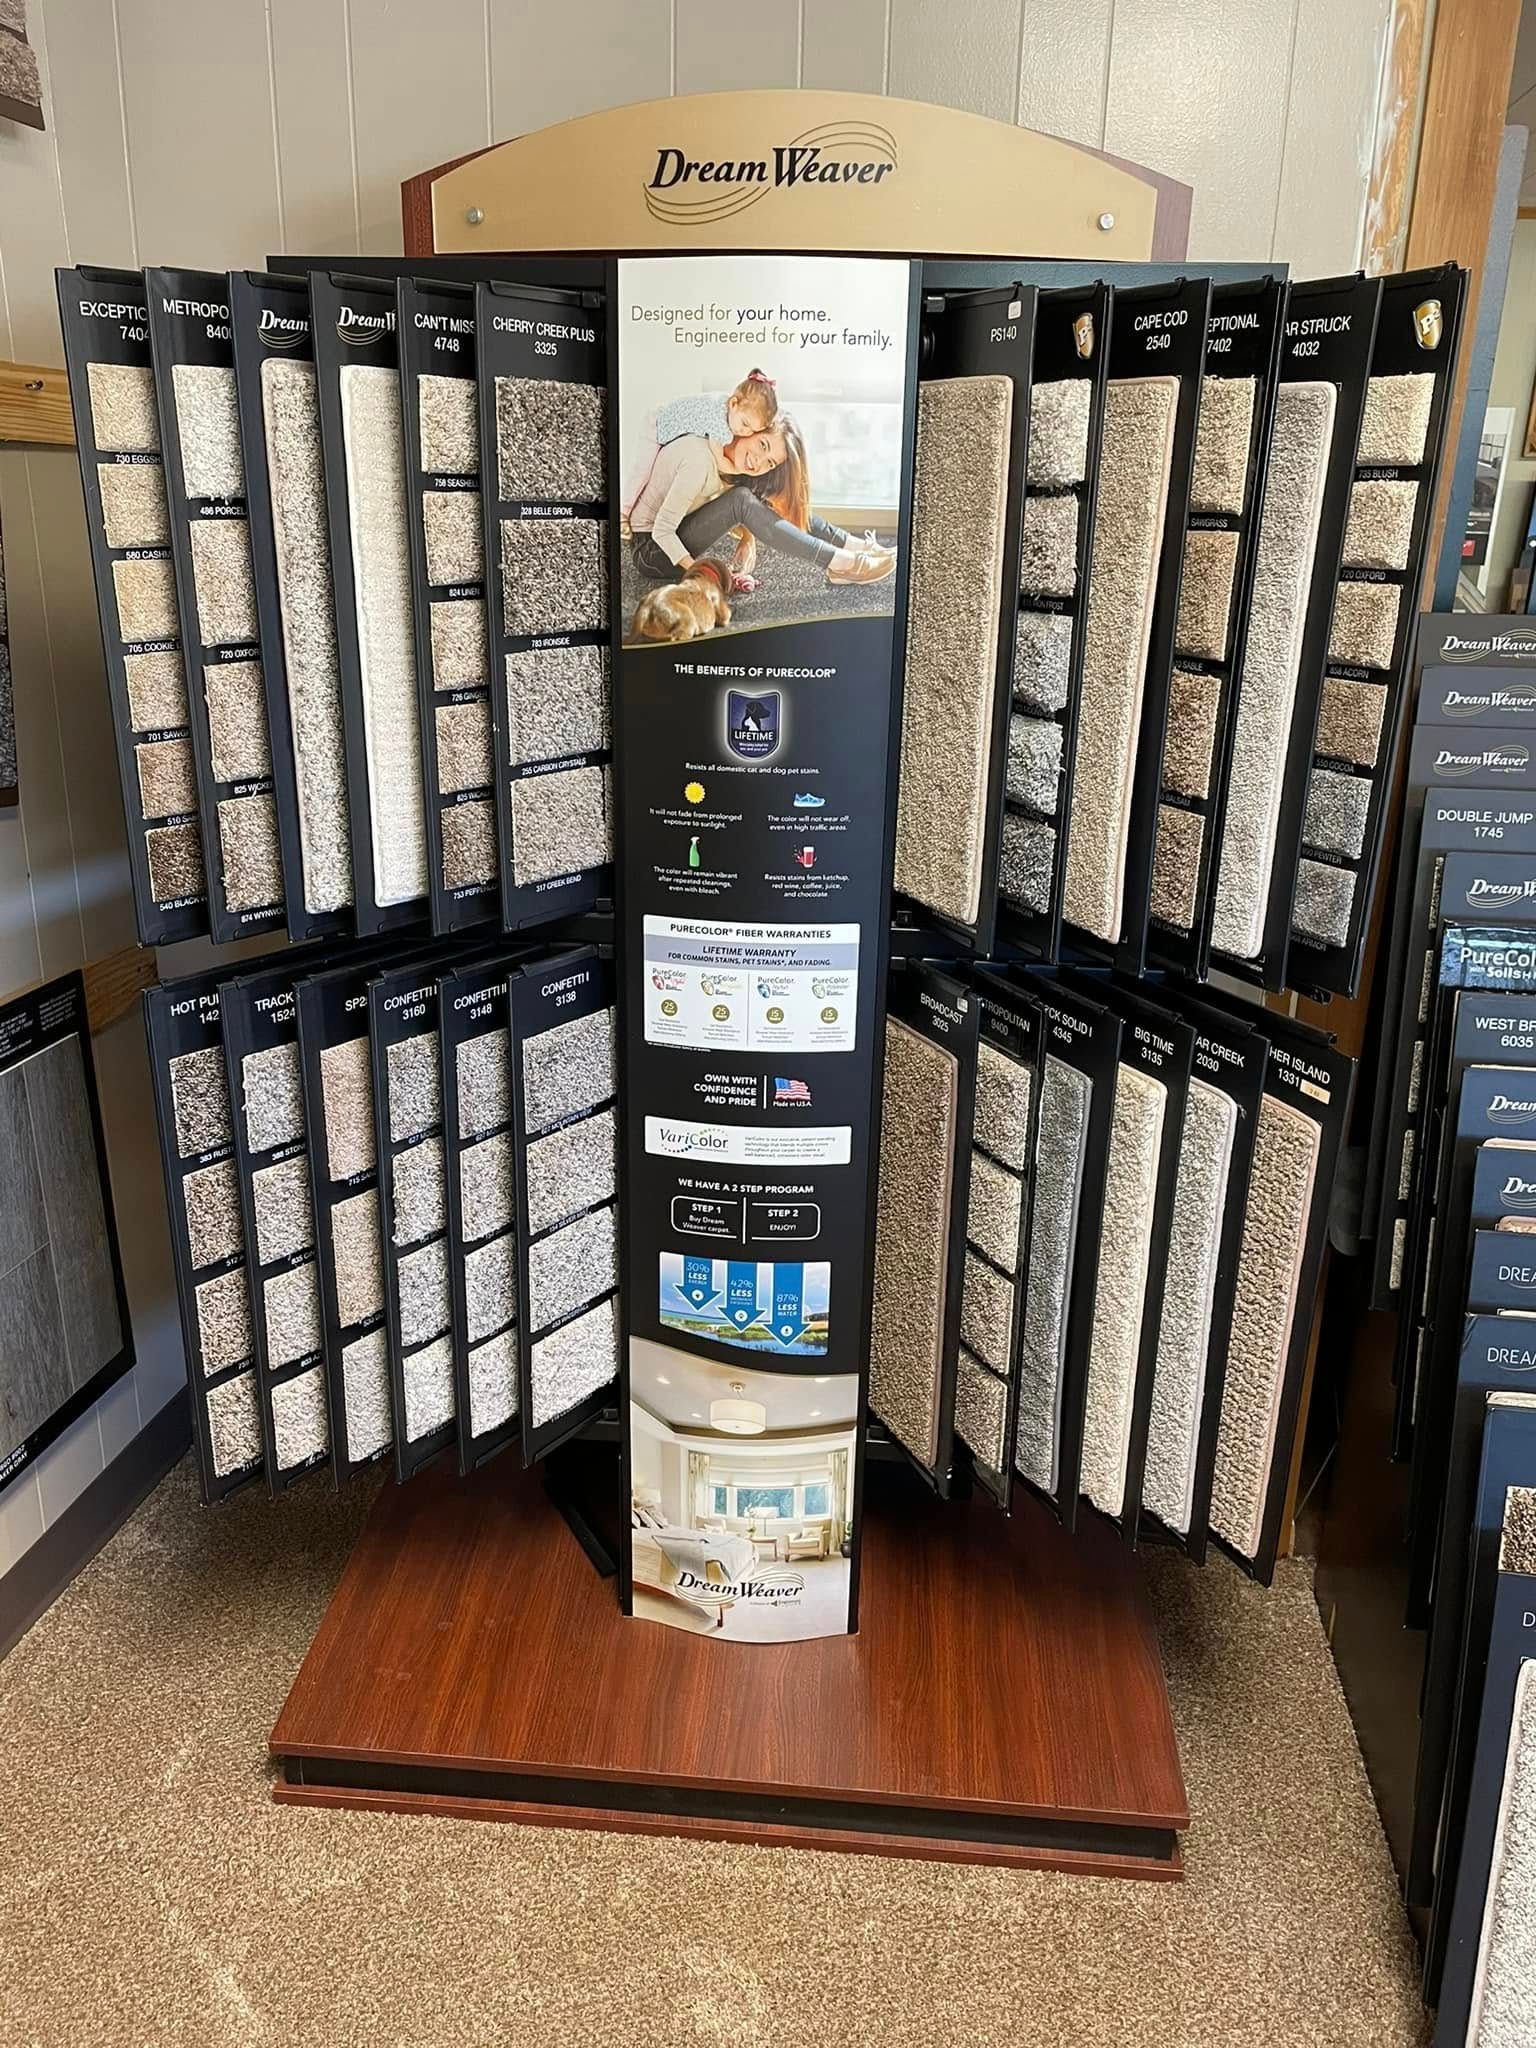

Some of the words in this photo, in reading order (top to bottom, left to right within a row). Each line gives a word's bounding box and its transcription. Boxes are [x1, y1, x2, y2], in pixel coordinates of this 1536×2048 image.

[631, 305, 704, 324] Designed
[709, 304, 732, 320] for
[736, 309, 774, 325] your
[779, 304, 832, 322] home.
[1134, 313, 1162, 331] CAPE
[1163, 310, 1188, 328] COD
[414, 313, 448, 332] CAN'T
[493, 316, 535, 335] CHERRY
[536, 321, 569, 339] CREEK
[570, 327, 596, 343] PLUS
[1300, 315, 1352, 335] STRUCK
[674, 327, 766, 347] Engineered
[772, 327, 796, 343] for
[799, 331, 837, 348] your
[841, 327, 894, 350] family.
[990, 325, 1017, 343] PS140
[434, 336, 460, 353] 4748
[534, 341, 558, 356] 3325
[1146, 334, 1171, 351] 2540
[1292, 341, 1320, 356] 4032
[1372, 469, 1399, 479] BLUSH
[532, 506, 552, 516] BELLE
[552, 506, 573, 516] GROVE
[1191, 517, 1228, 529] SAWGRASS
[1355, 571, 1386, 581] OXFORD
[128, 644, 142, 654] 705
[143, 642, 176, 652] COOKIE
[543, 636, 571, 646] IRONSIDE
[674, 663, 694, 675] THE
[696, 665, 746, 676] BENEFITS
[747, 667, 764, 677] OF
[734, 731, 773, 741] LIFETIME
[685, 762, 707, 771] Resists
[707, 764, 715, 772] all
[716, 764, 746, 773] domestic
[758, 765, 771, 774] and
[772, 766, 787, 776] dog
[787, 767, 799, 776] pet
[1437, 809, 1492, 823] DOUBLE
[1494, 812, 1533, 825] JUMP
[1473, 826, 1504, 839] 1745
[1313, 849, 1342, 865] PEWTER
[653, 865, 665, 874] The
[665, 867, 681, 875] color
[764, 873, 786, 881] Resists
[159, 901, 174, 912] 540
[736, 929, 764, 938] FIBER
[765, 929, 832, 939] WARRANTIES
[668, 951, 682, 960] FOR
[682, 953, 714, 963] COMMON
[742, 958, 755, 966] PET
[702, 945, 743, 957] LIFETIME
[744, 948, 797, 957] WARRANTY
[541, 974, 585, 997] CONFETTI
[254, 992, 295, 1012] TRACK
[344, 999, 368, 1013] SP2
[384, 986, 433, 1012] CONFETTI
[453, 986, 500, 1011] CONFETTI
[555, 991, 577, 1008] 3138
[170, 999, 197, 1017] HOT
[270, 1007, 296, 1024] 1524
[402, 1003, 427, 1020] 3160
[470, 1003, 493, 1020] 3148
[920, 992, 964, 1026] BROADCAST
[199, 1009, 220, 1024] 142
[1062, 1012, 1087, 1035] SOLID
[1475, 1016, 1515, 1031] WEST
[931, 1015, 950, 1034] 3025
[1052, 1025, 1073, 1044] 4345
[1134, 1026, 1151, 1044] BIG
[1152, 1034, 1174, 1056] TIME
[1501, 1035, 1534, 1048] 6035
[1141, 1047, 1163, 1067] 3135
[1211, 1042, 1245, 1068] CREEK
[1196, 1053, 1220, 1073] 2030
[1277, 1067, 1300, 1087] 1331
[1291, 1057, 1331, 1085] ISLAND
[704, 1073, 730, 1084] OWN
[731, 1075, 757, 1086] WITH
[693, 1083, 757, 1096] CONFIDENCE
[704, 1095, 727, 1105] AND
[728, 1096, 757, 1107] PRIDE
[659, 1127, 729, 1149] VariColor
[678, 1177, 693, 1188] WE
[695, 1180, 720, 1191] HAVE
[722, 1183, 730, 1192] A
[732, 1184, 738, 1193] 2
[739, 1184, 763, 1194] STEP
[765, 1185, 814, 1194] PROGRAM
[691, 1202, 714, 1213] STEP
[716, 1204, 721, 1214] 1
[767, 1209, 791, 1218] STEP
[792, 1209, 799, 1218] 2
[688, 1214, 701, 1225] Buy
[702, 1215, 725, 1225] Dream
[686, 1261, 710, 1274] 30%
[688, 1272, 708, 1281] LESS
[730, 1279, 754, 1289] 42%
[730, 1289, 753, 1298] LESS
[776, 1293, 799, 1304] 87%
[777, 1303, 798, 1312] LESS
